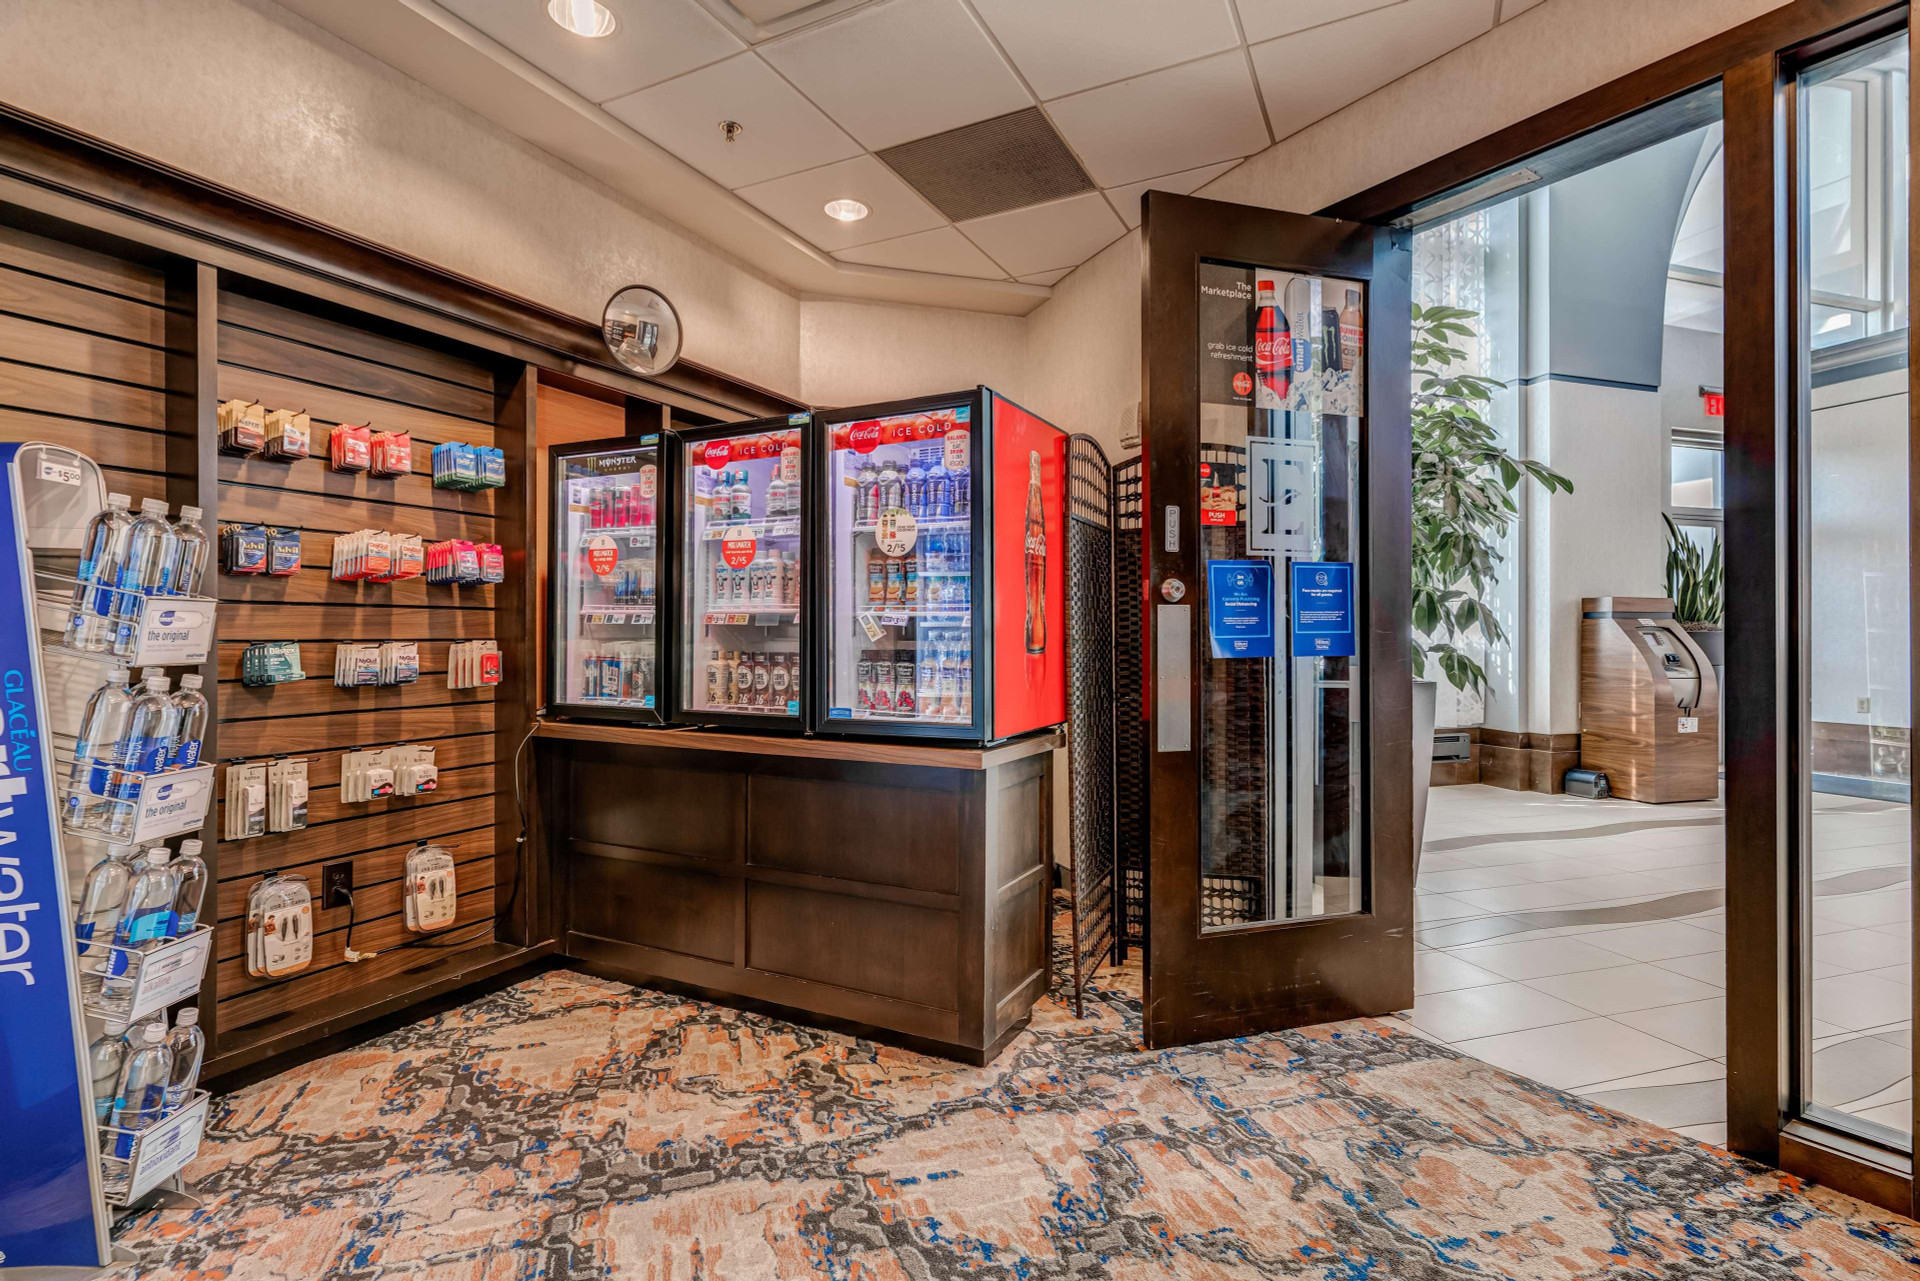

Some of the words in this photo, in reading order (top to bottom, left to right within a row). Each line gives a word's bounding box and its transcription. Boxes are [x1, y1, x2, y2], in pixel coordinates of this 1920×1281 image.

[1200, 285, 1252, 299] Marketplace
[1236, 281, 1252, 291] The
[1207, 342, 1225, 350] grab
[1225, 343, 1237, 351] ice
[1238, 345, 1253, 353] cold
[1210, 351, 1253, 362] refreshment
[850, 425, 880, 441] Coca-Cola
[893, 427, 912, 437] ICE
[918, 422, 952, 433] COLD
[705, 445, 730, 458] Coca-Cola
[739, 446, 756, 455] ICE
[760, 442, 788, 453] COLD
[598, 456, 637, 467] MONSTER
[1208, 511, 1226, 519] PUSH
[1168, 509, 1177, 549] PUSH
[277, 546, 299, 554] Advil
[147, 630, 161, 641] the
[161, 629, 190, 644] original
[269, 647, 296, 655] Blistex
[4, 669, 37, 772] GLACÉAU
[186, 740, 200, 765] water
[145, 807, 158, 819] the
[159, 799, 188, 816] original
